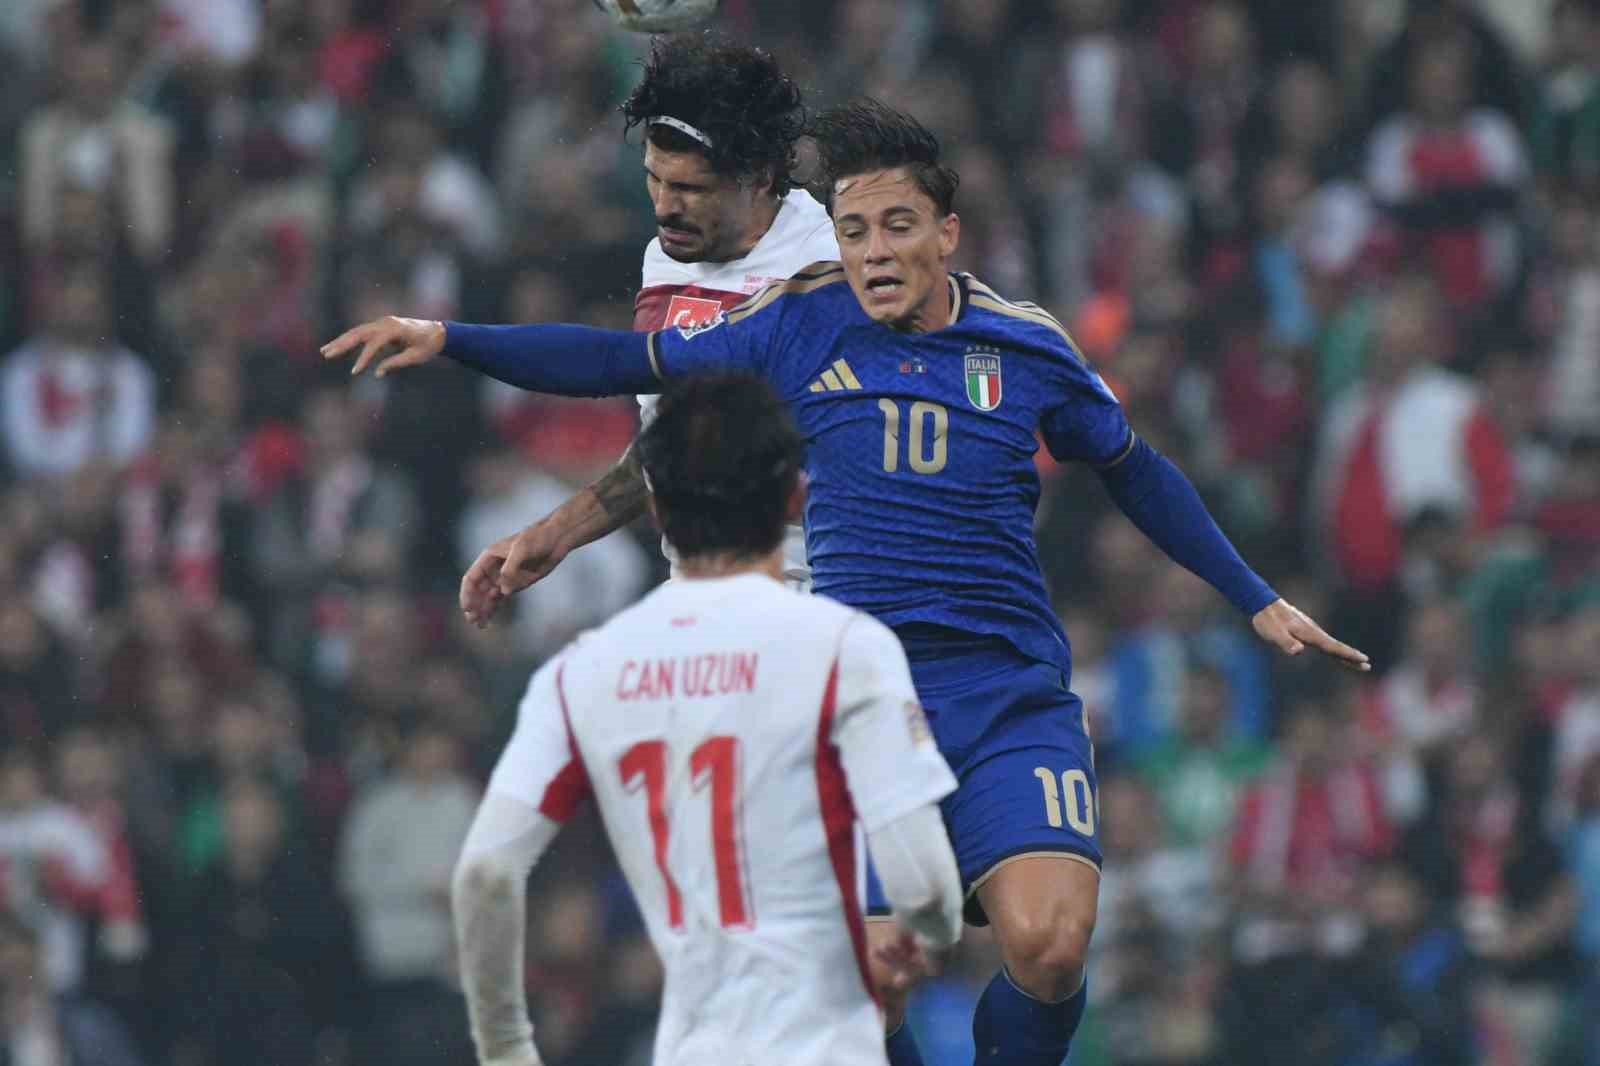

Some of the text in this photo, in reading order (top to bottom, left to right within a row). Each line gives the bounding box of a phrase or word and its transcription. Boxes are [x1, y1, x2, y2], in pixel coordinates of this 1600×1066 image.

[967, 358, 998, 369] ITALIA
[878, 398, 948, 474] 10
[616, 650, 758, 701] CAN UZUN
[617, 735, 754, 930] 11
[1034, 767, 1094, 837] 10
